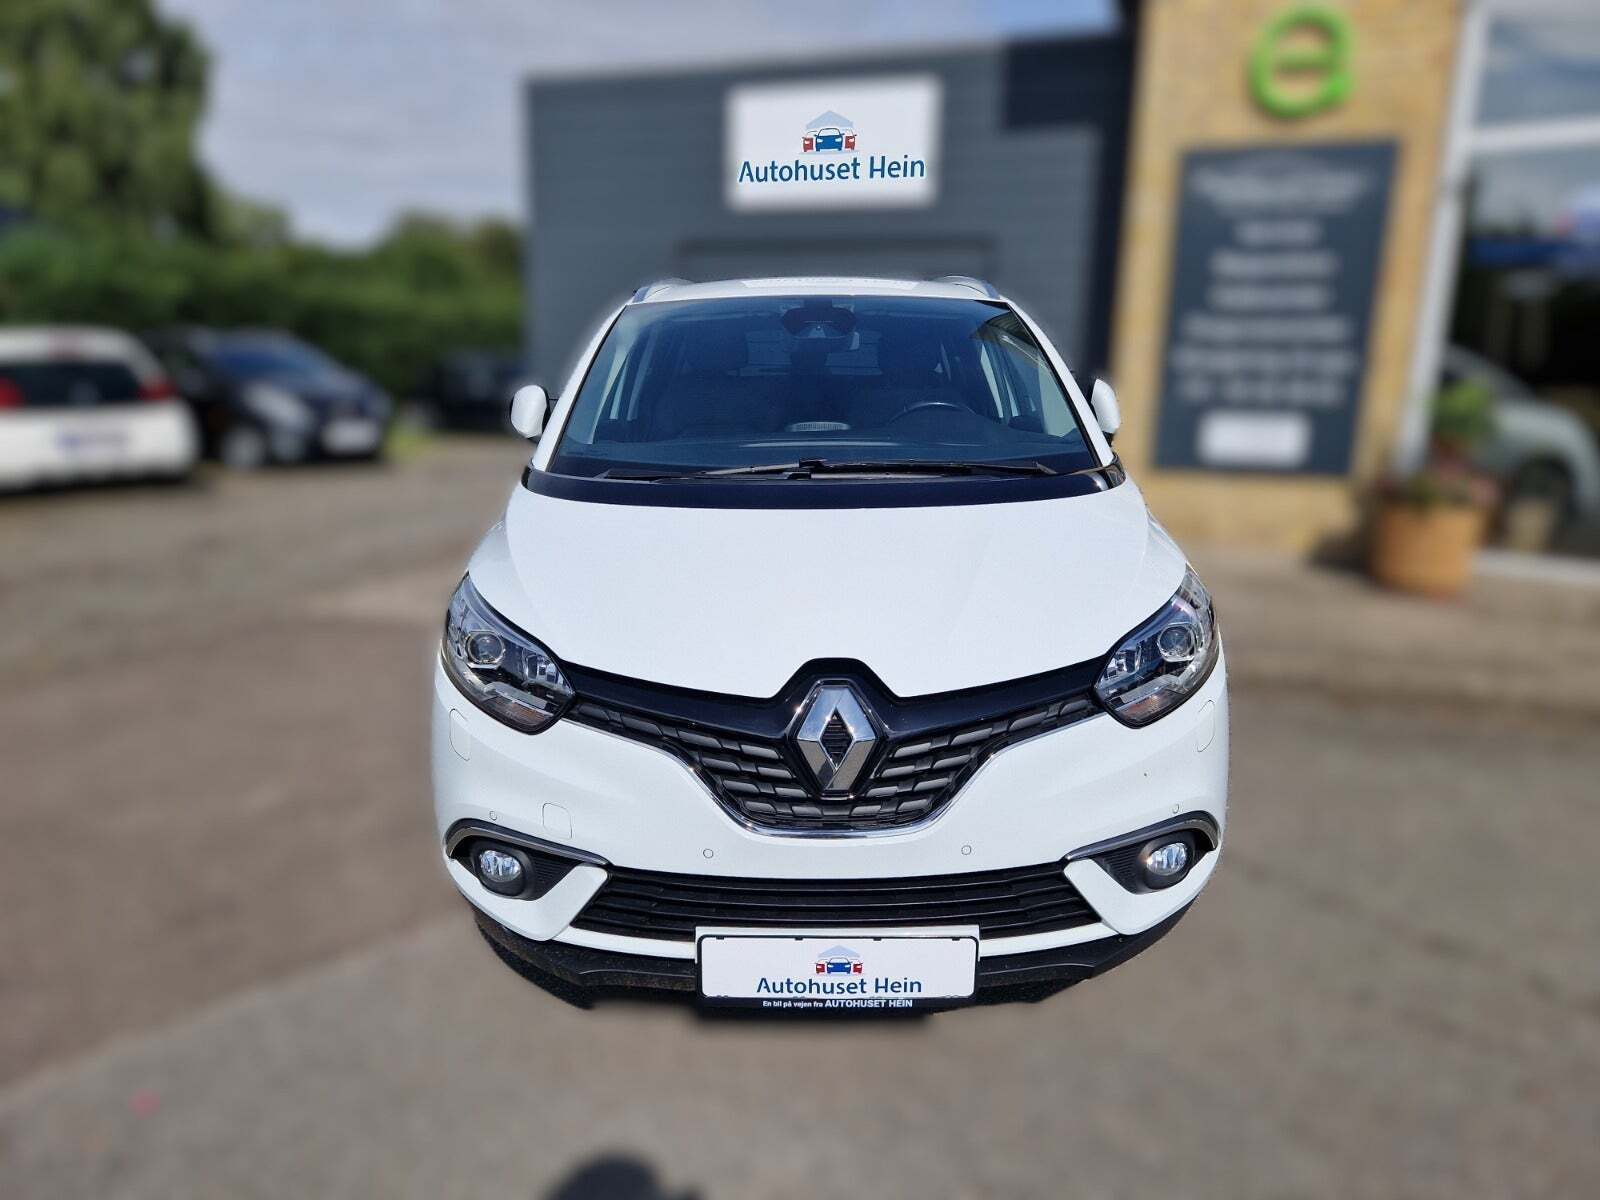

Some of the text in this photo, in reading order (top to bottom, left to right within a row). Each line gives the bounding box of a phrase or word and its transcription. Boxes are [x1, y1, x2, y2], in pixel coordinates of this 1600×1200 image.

[738, 154, 926, 183] Autohuset Hein
[756, 977, 922, 995] Autohuset Hein
[783, 1000, 792, 1008] på
[824, 999, 887, 1008] AUTOHUSET
[888, 999, 913, 1008] HEIN
